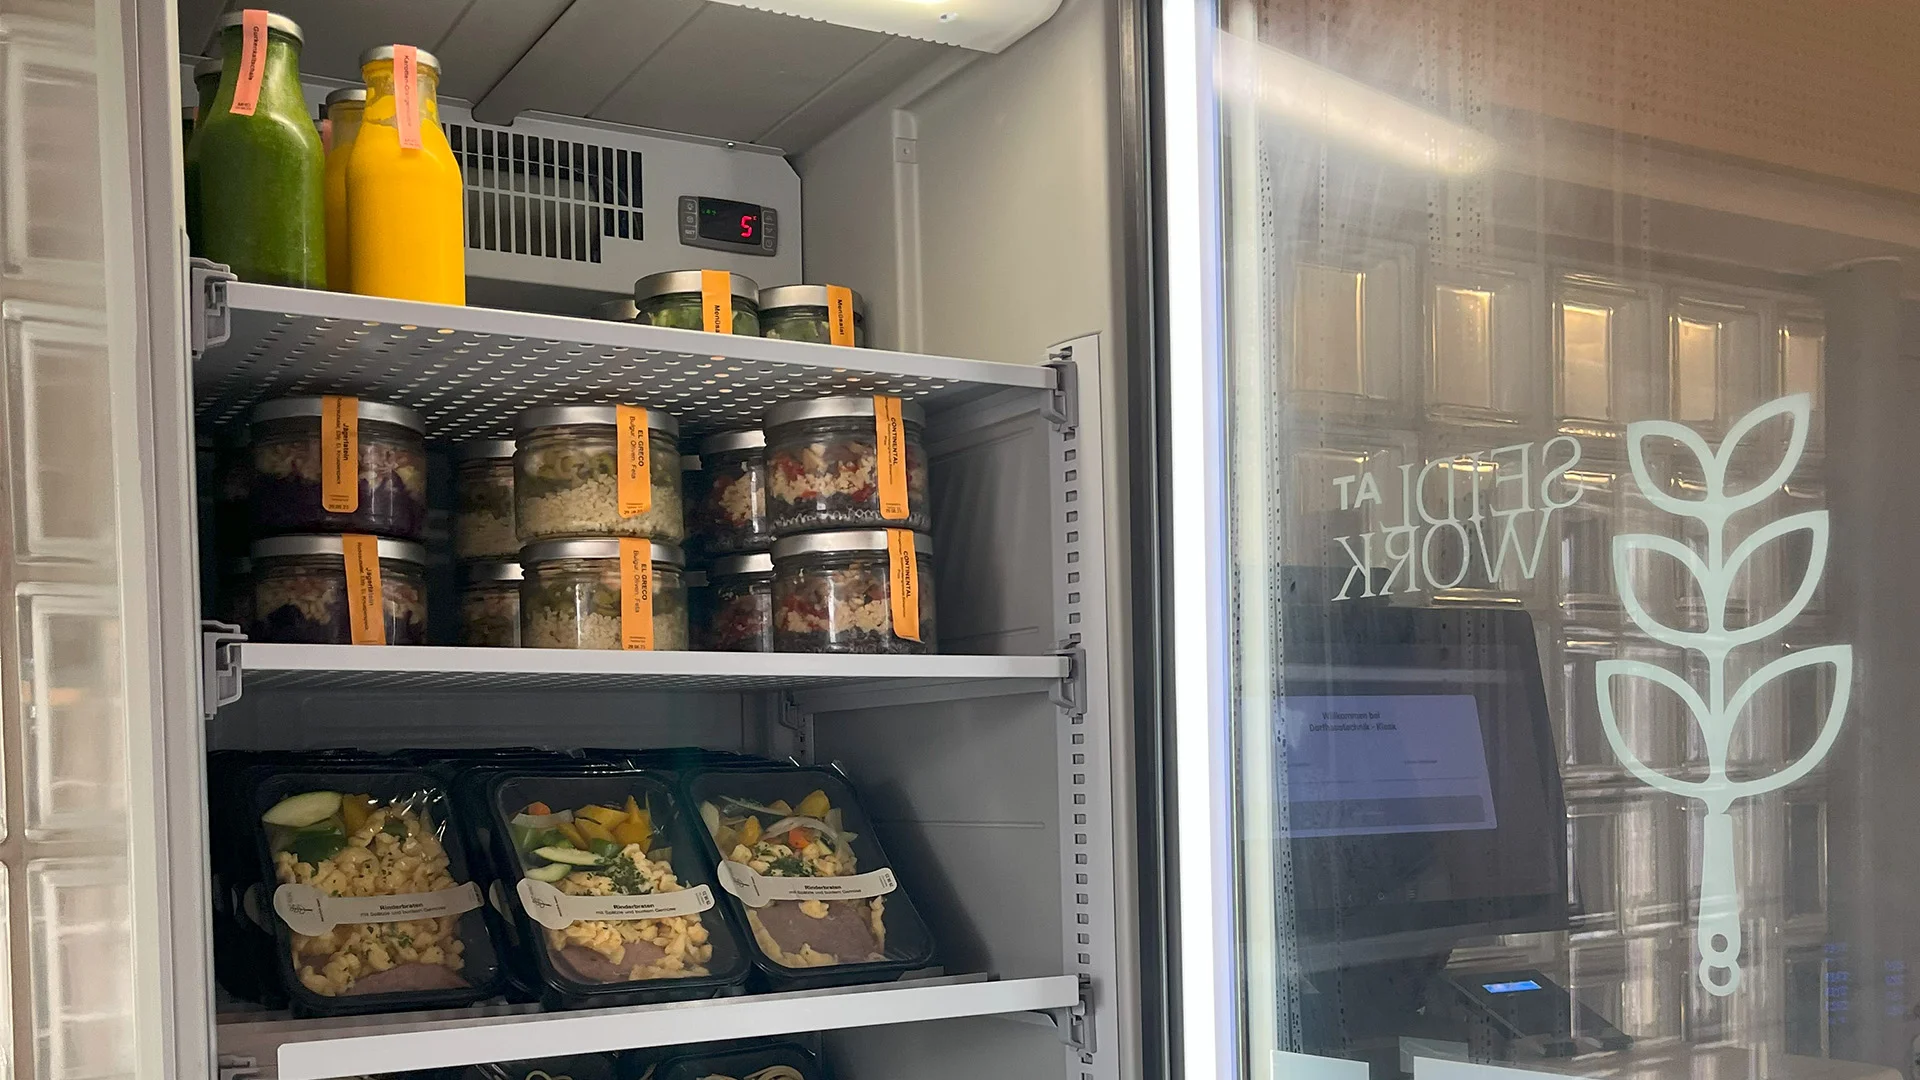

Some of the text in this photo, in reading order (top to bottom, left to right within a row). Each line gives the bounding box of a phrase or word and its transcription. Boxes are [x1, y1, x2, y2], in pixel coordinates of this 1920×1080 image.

[740, 215, 753, 238] 5
[638, 430, 644, 438] EL
[890, 417, 898, 465] CONTINENTAL
[641, 563, 647, 572] EL
[903, 550, 911, 598] CONTINENTAL
[380, 902, 423, 910] Rinderbraten
